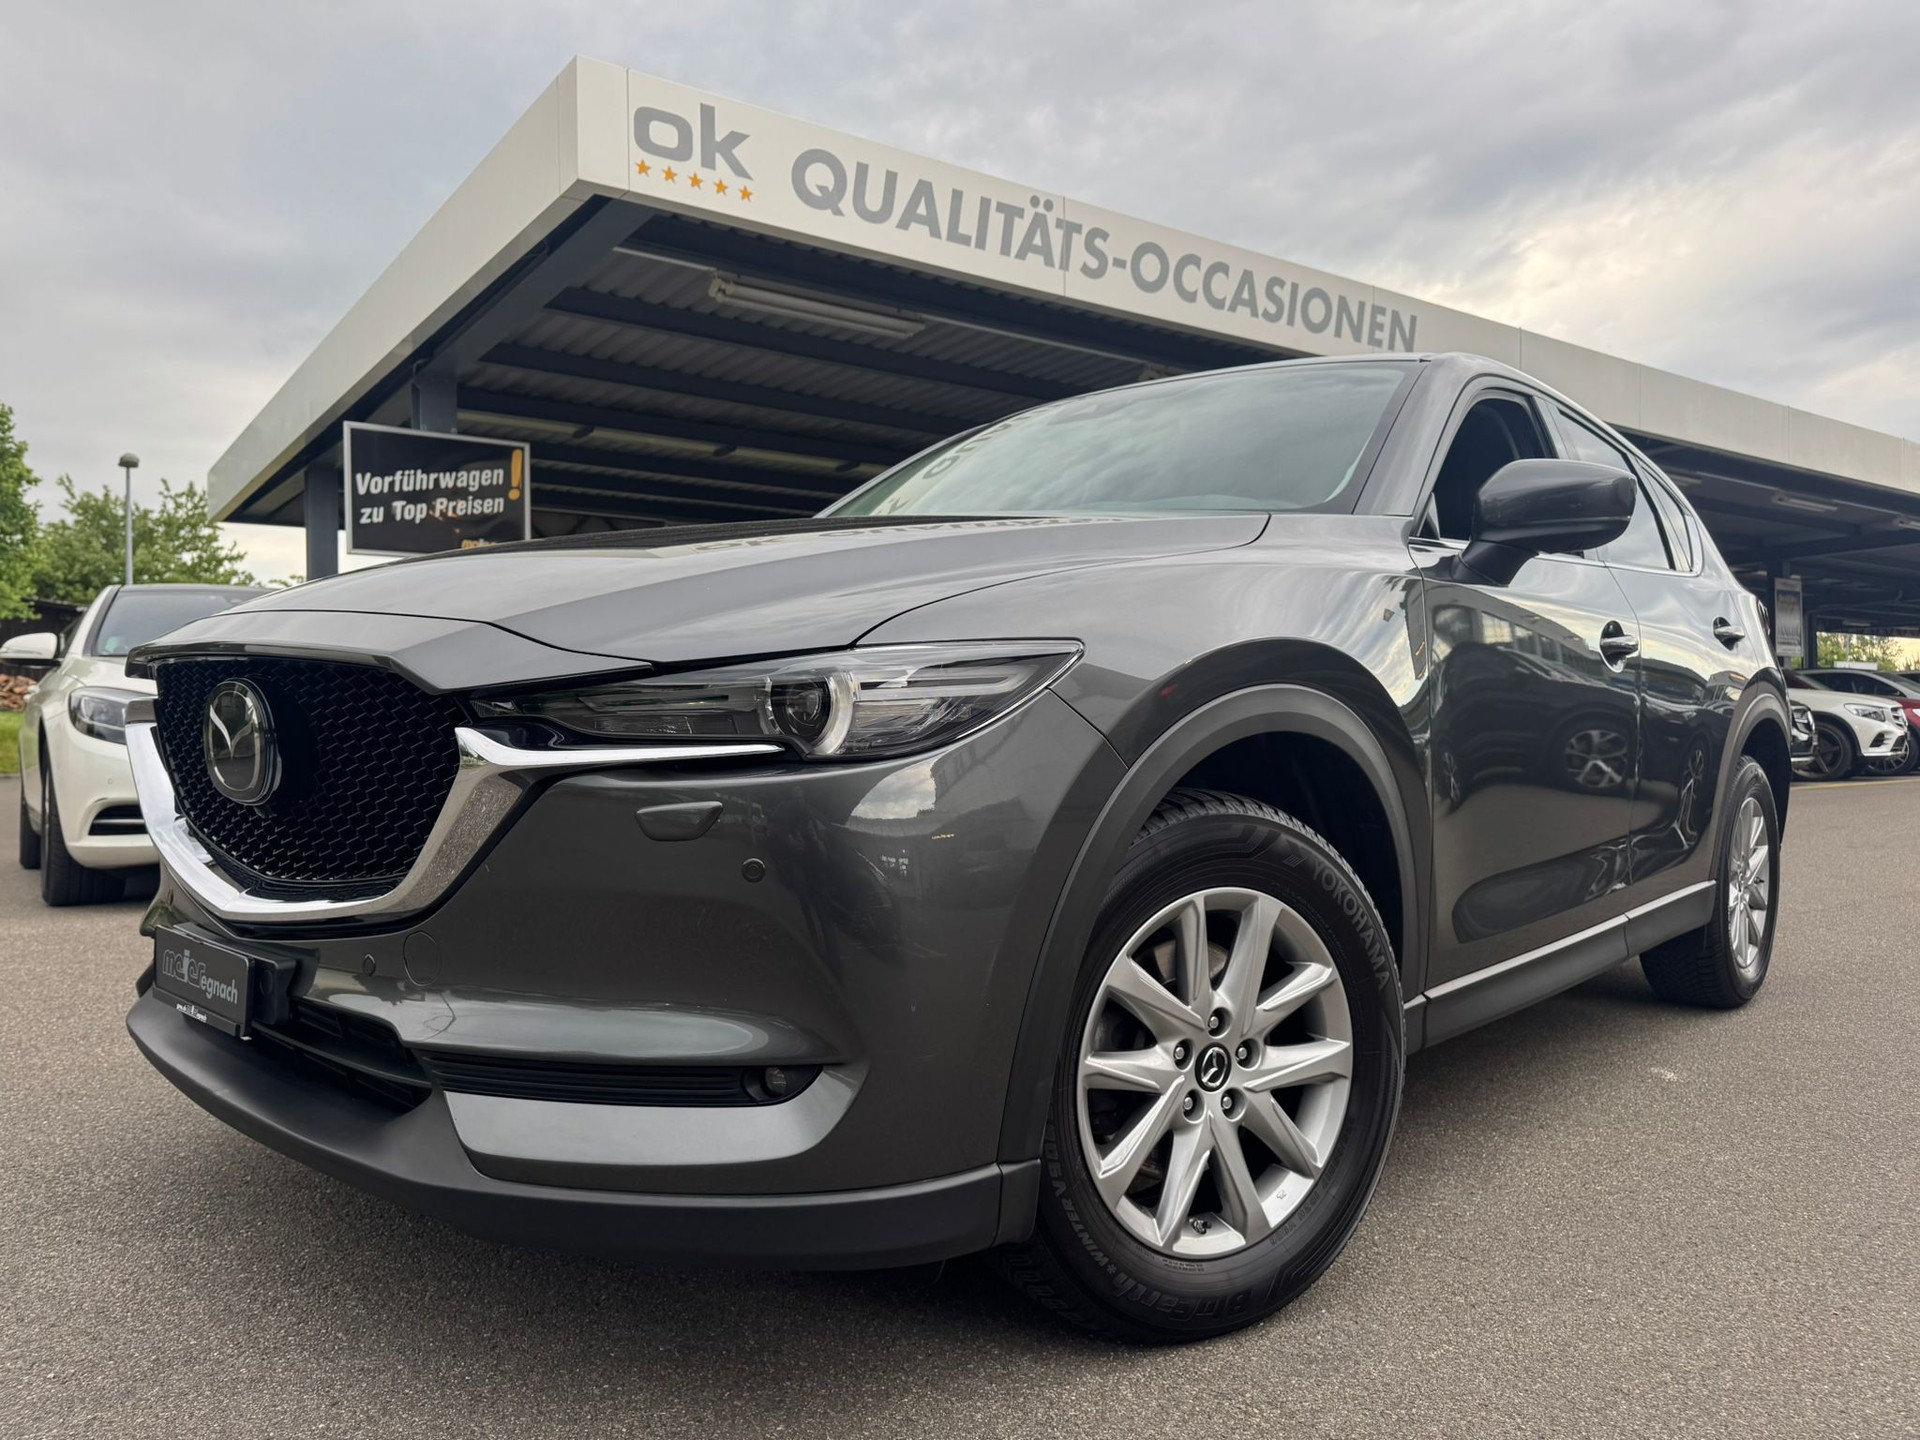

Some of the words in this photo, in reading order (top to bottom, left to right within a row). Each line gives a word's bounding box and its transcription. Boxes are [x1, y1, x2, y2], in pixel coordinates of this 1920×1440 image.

[633, 102, 754, 181] ok
[790, 147, 1418, 353] QUALITÄTS-OCCASIONEN
[355, 467, 504, 496] Vorführwagen
[359, 506, 384, 525] zu
[392, 500, 428, 525] Top
[434, 496, 505, 518] Preisen
[1313, 860, 1390, 992] YOKOHAMA
[200, 974, 238, 1005] egnach
[1062, 1198, 1109, 1267] WINTER
